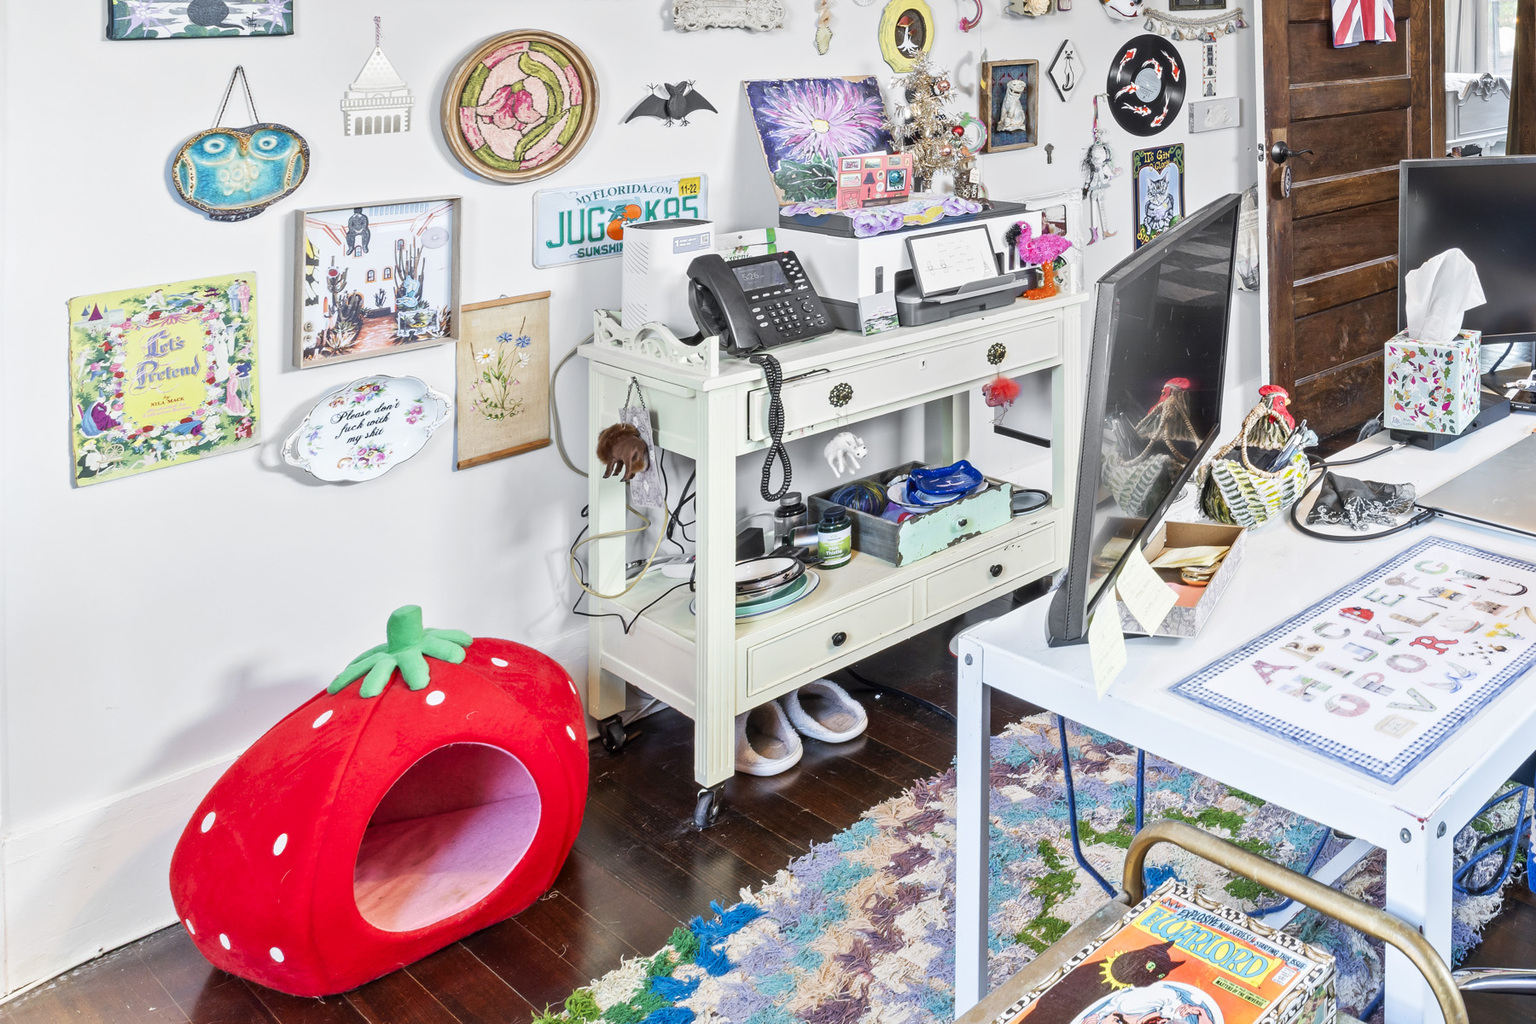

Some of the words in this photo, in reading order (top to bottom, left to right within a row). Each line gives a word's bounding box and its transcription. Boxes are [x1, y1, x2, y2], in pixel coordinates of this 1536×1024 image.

[576, 184, 673, 206] MYFLORIDA.COM
[680, 183, 698, 195] 11-22
[545, 207, 605, 249] JUG
[144, 329, 185, 360] Let's
[133, 353, 200, 390] Pretend
[167, 396, 184, 404] MACK
[330, 409, 372, 425] Please
[373, 398, 400, 414] don't
[335, 418, 365, 440] fuck
[366, 412, 392, 427] with
[346, 434, 362, 446] my
[365, 426, 385, 439] shit
[1251, 660, 1297, 685] A
[1313, 621, 1351, 640] C
[1339, 606, 1375, 624] D
[1362, 587, 1407, 607] E
[1414, 560, 1449, 576] G
[1343, 642, 1379, 662] J
[1364, 624, 1412, 646] K
[1389, 611, 1439, 627] L
[1353, 672, 1396, 697] P
[1409, 635, 1459, 656] R
[1387, 687, 1437, 713] V
[1150, 914, 1269, 979] WARLORD
[1177, 908, 1222, 927] EXPLOSIVE
[1254, 940, 1280, 957] STARTING
